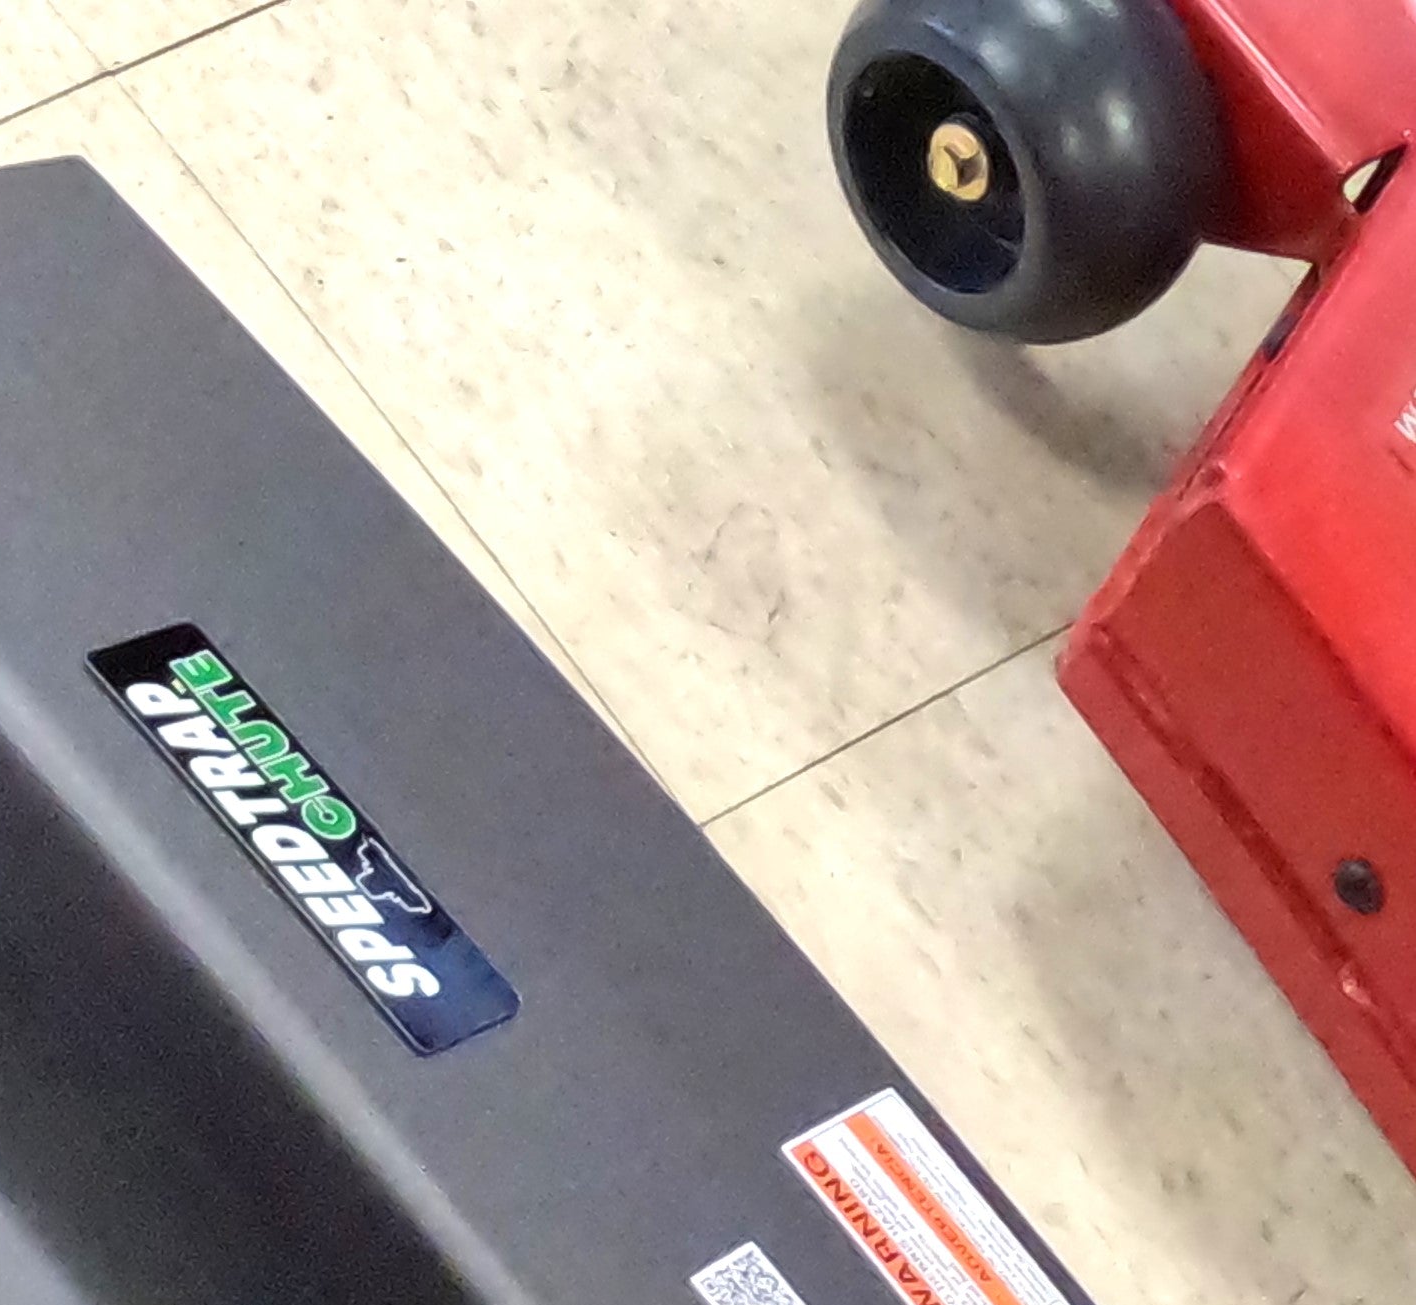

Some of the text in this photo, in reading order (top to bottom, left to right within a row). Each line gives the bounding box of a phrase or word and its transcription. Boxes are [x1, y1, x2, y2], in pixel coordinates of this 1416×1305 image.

[170, 650, 356, 839] CHUTE
[126, 683, 440, 998] SPEEDTRAP
[848, 1176, 899, 1237] HAZARD
[874, 1141, 992, 1280] ADVERTENCIA
